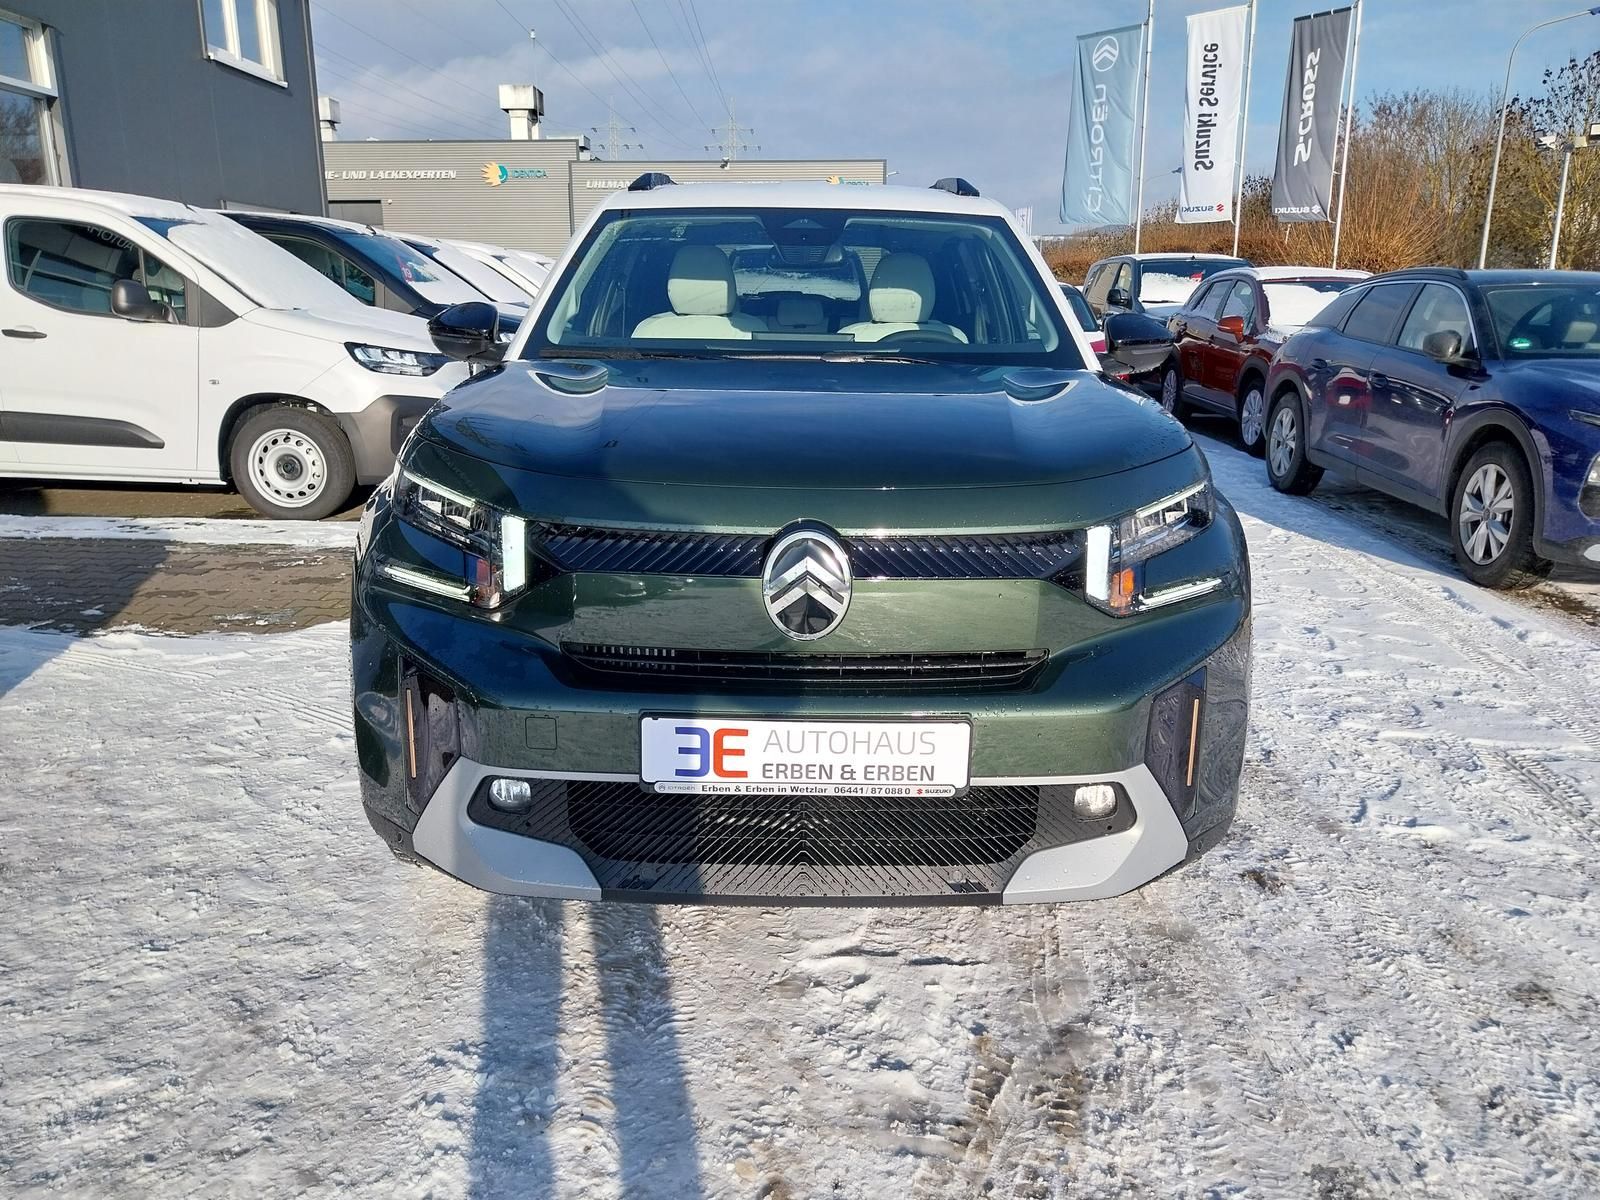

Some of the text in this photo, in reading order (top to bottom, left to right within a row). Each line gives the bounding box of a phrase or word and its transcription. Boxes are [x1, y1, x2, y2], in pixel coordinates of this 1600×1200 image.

[342, 170, 366, 180] UND
[370, 170, 457, 180] LACKEXPERTEN
[763, 729, 936, 755] AUTOHAUS
[762, 763, 935, 782] ERBEN & ERBEN
[701, 784, 731, 793] Erben
[734, 785, 742, 793] &
[745, 785, 774, 793] Erben
[777, 785, 787, 793] in
[790, 785, 828, 794] Wetzlar
